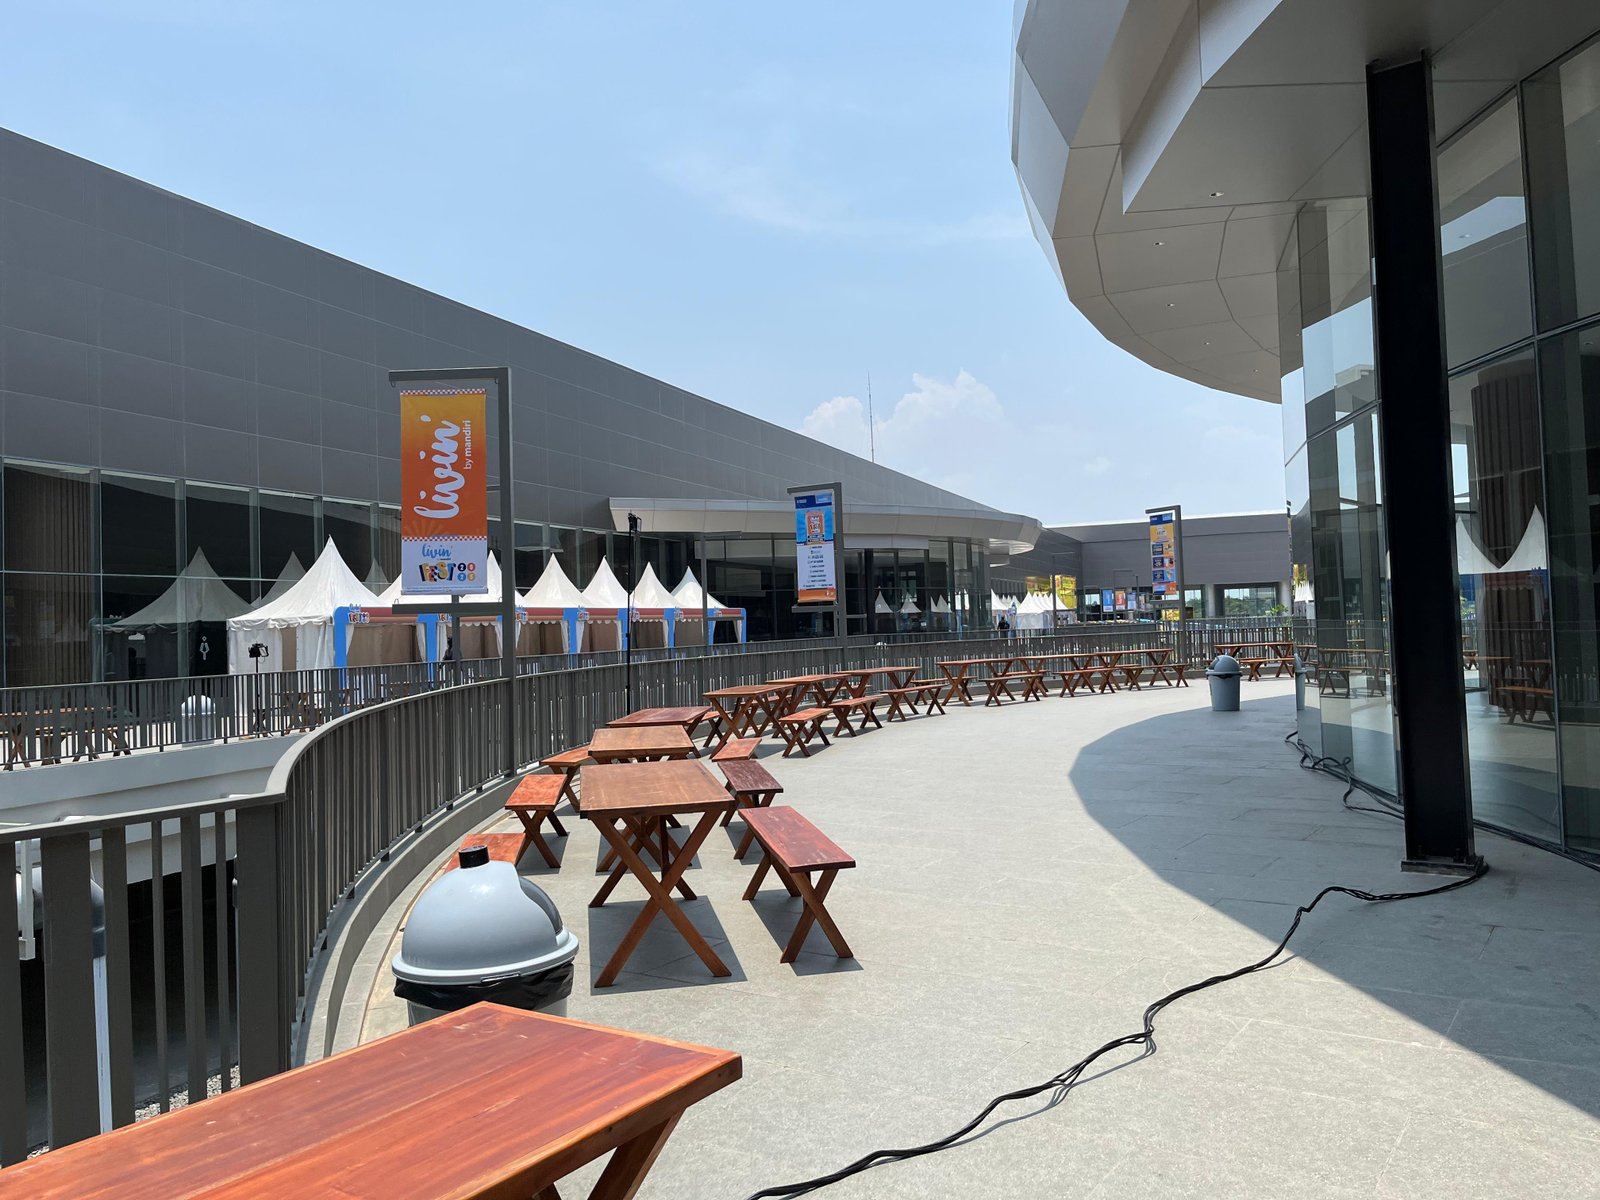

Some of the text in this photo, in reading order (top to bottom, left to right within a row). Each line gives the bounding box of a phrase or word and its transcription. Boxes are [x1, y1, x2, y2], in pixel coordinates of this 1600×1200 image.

[463, 420, 472, 470] by mandiri
[419, 561, 457, 583] FEST
